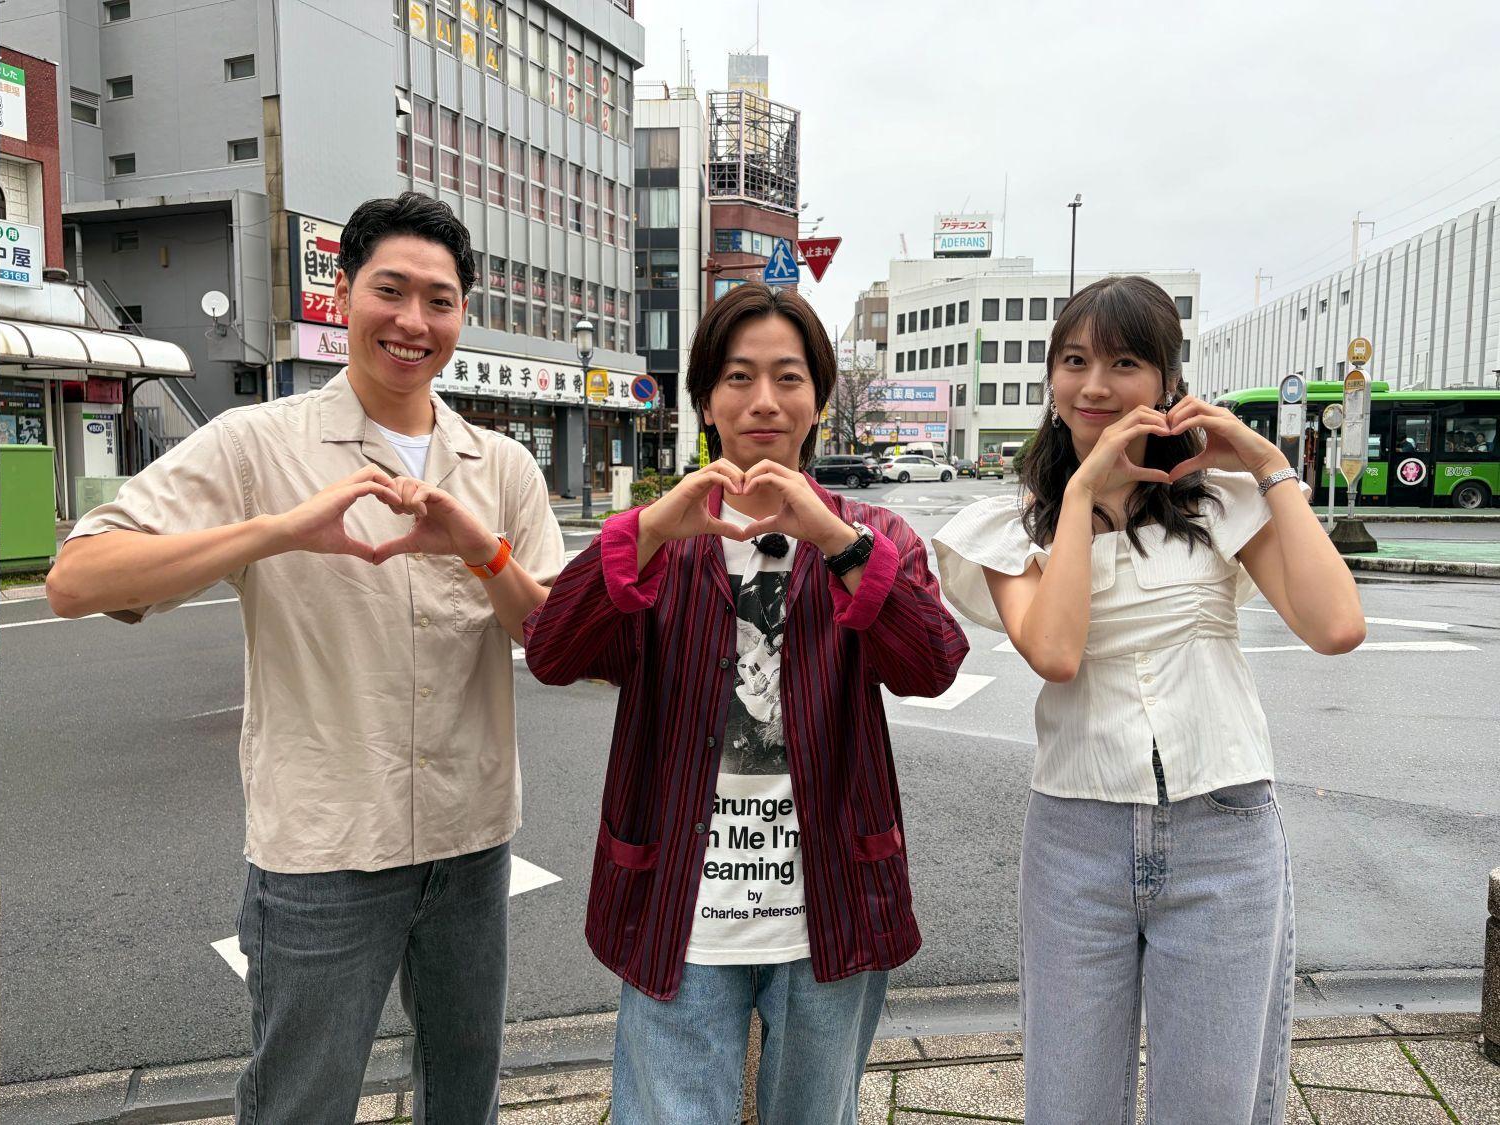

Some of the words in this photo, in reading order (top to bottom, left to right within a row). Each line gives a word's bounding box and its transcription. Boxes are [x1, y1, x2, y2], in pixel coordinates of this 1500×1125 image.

[0, 66, 18, 80] した
[303, 221, 318, 234] 2F
[940, 221, 988, 230] アデランス
[941, 237, 985, 249] ADERANS
[805, 247, 832, 258] 止まれ
[304, 293, 340, 313] ランチ
[436, 359, 532, 387] 家製餃子
[105, 421, 114, 454] 証明写真
[1444, 467, 1472, 477] BUS
[728, 826, 765, 849] Me
[703, 857, 794, 885] eaming
[747, 889, 763, 904] by
[701, 906, 749, 919] Charles
[752, 905, 806, 919] Peterson
